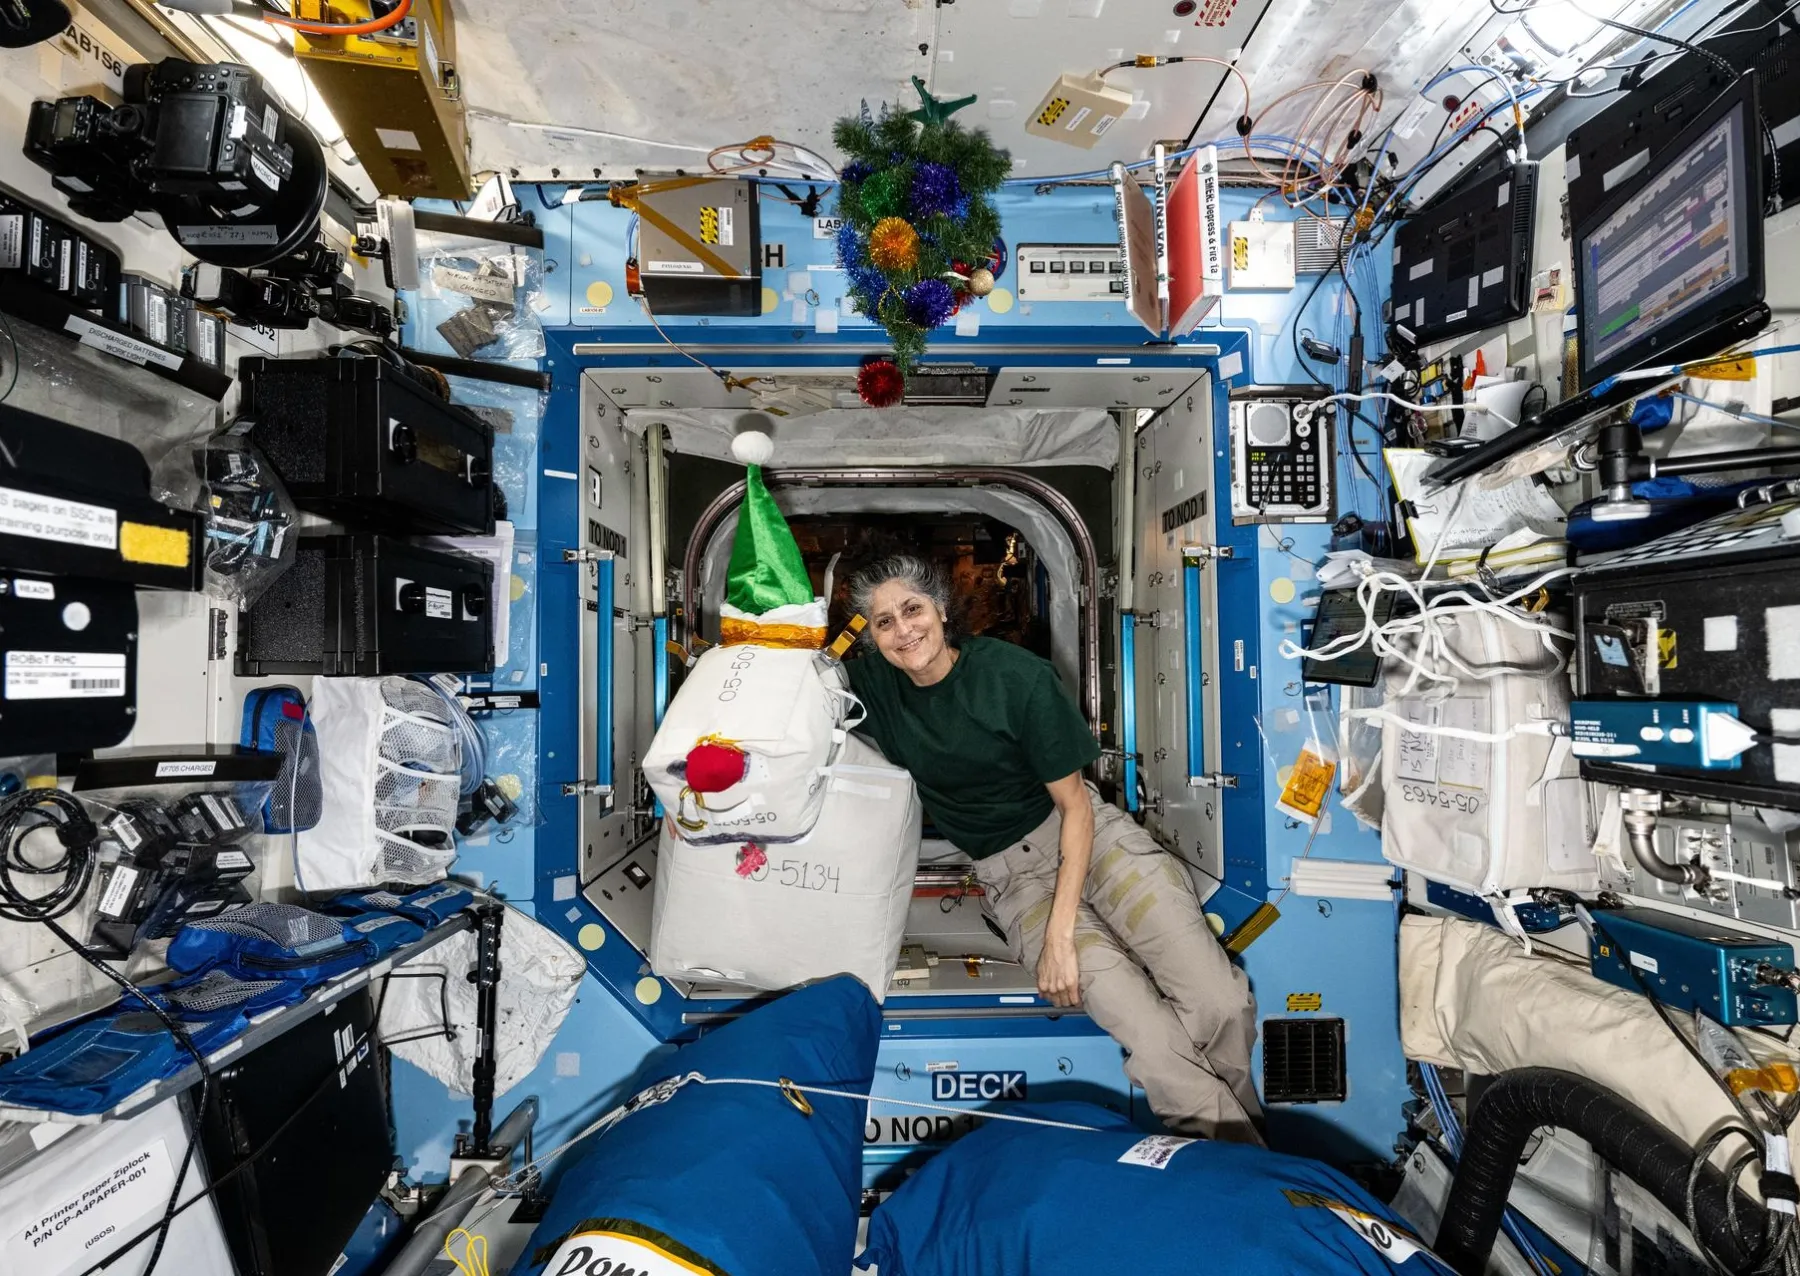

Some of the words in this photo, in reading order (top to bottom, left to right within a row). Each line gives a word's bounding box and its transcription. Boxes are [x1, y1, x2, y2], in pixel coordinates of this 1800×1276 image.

[62, 24, 122, 78] AB1S6
[252, 160, 273, 183] MACRO
[1115, 191, 1124, 226] PORTABLE
[1155, 172, 1165, 258] WARNING
[1204, 203, 1216, 237] Depress
[1118, 226, 1127, 259] ONBOARD
[1120, 259, 1130, 300] COMPUTERS
[88, 327, 133, 349] DISCHARGED
[133, 344, 167, 361] BATTERIES
[126, 351, 145, 363] LIGHT
[12, 498, 49, 513] pages
[52, 505, 67, 515] on
[70, 506, 95, 521] SSC
[98, 514, 114, 525] are
[1162, 509, 1175, 534] TO
[1177, 497, 1197, 527] NOD
[1200, 491, 1205, 516] 1
[45, 524, 90, 541] purpose
[92, 532, 114, 544] only
[589, 519, 601, 546] TO
[604, 526, 621, 555] NOD
[53, 655, 77, 665] RHC
[159, 764, 180, 773] XF705
[180, 764, 214, 773] CHARGED
[936, 1073, 1024, 1099] DECK
[891, 1116, 953, 1142] NOD
[24, 1224, 39, 1241] A4
[41, 1199, 80, 1229] Printer
[82, 1177, 111, 1202] Paper
[113, 1151, 151, 1180] Ziplock
[32, 1229, 53, 1248] P/N
[55, 1166, 147, 1233] CP-A4PAPER-001
[84, 1224, 117, 1249] (USOS)
